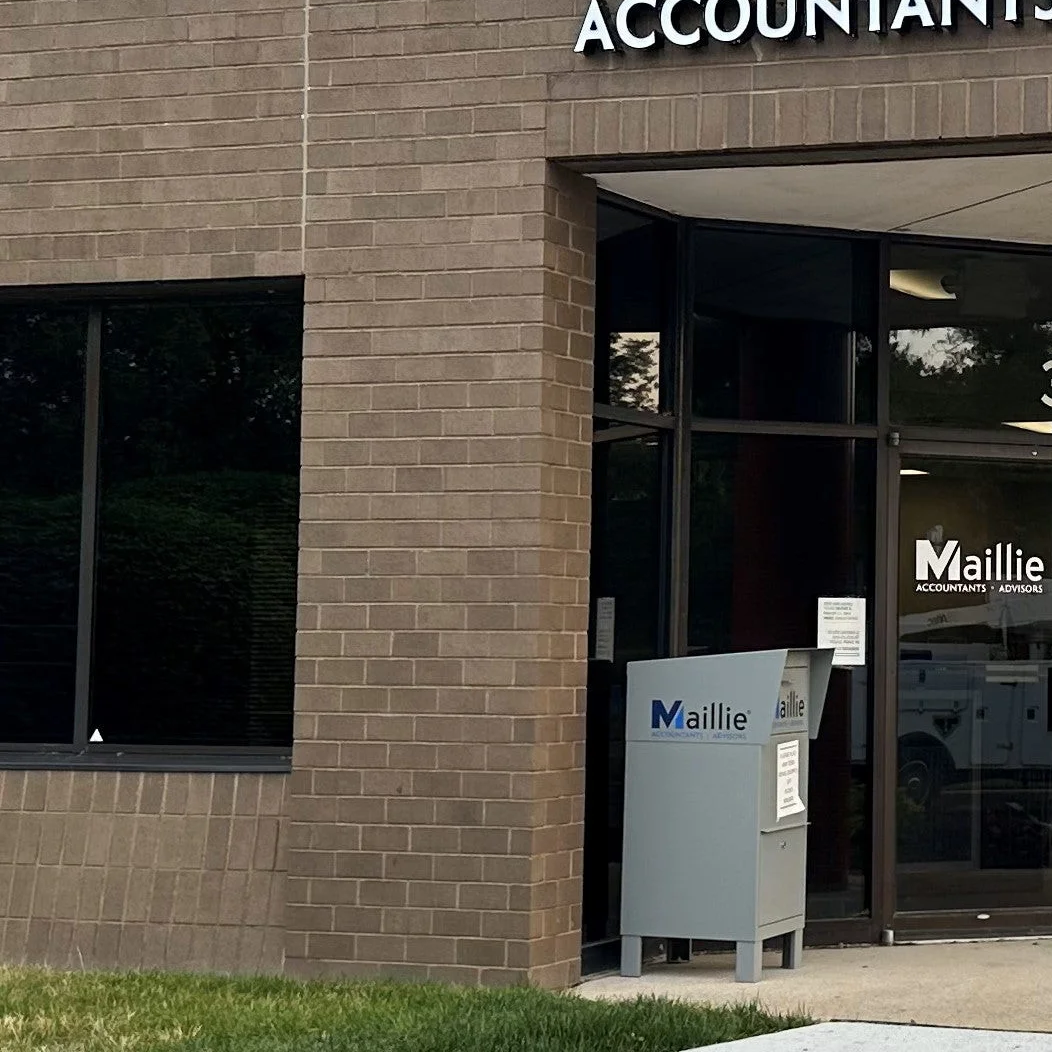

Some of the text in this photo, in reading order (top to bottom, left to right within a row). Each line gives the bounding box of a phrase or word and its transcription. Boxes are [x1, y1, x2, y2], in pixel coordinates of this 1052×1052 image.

[915, 539, 1045, 581] Maillie
[915, 582, 1044, 594] ACCOUNTANTS ADVISORS
[774, 691, 805, 719] aillie
